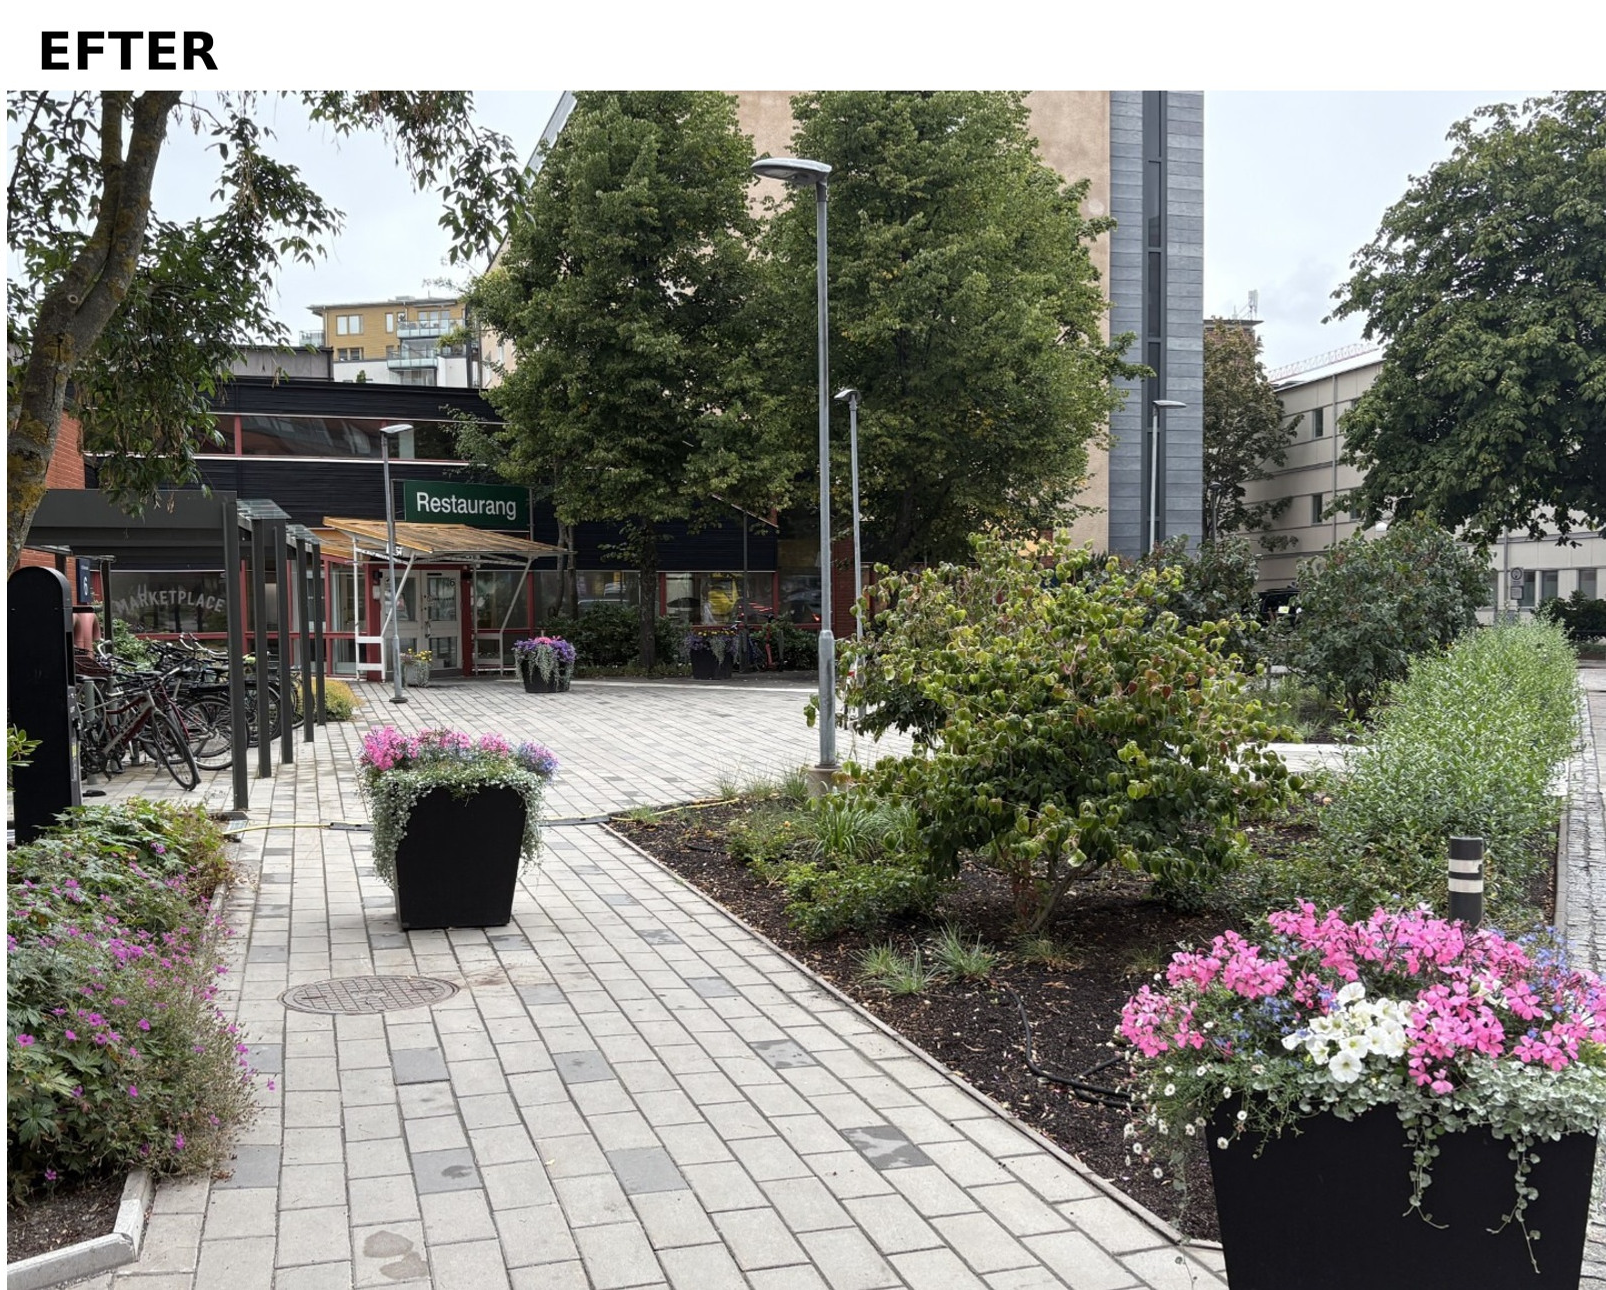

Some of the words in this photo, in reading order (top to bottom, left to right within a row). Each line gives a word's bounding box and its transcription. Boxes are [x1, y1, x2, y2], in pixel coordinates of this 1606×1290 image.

[416, 491, 517, 520] Restaurang
[83, 576, 89, 596] 6
[114, 590, 226, 614] MARKETPLACE
